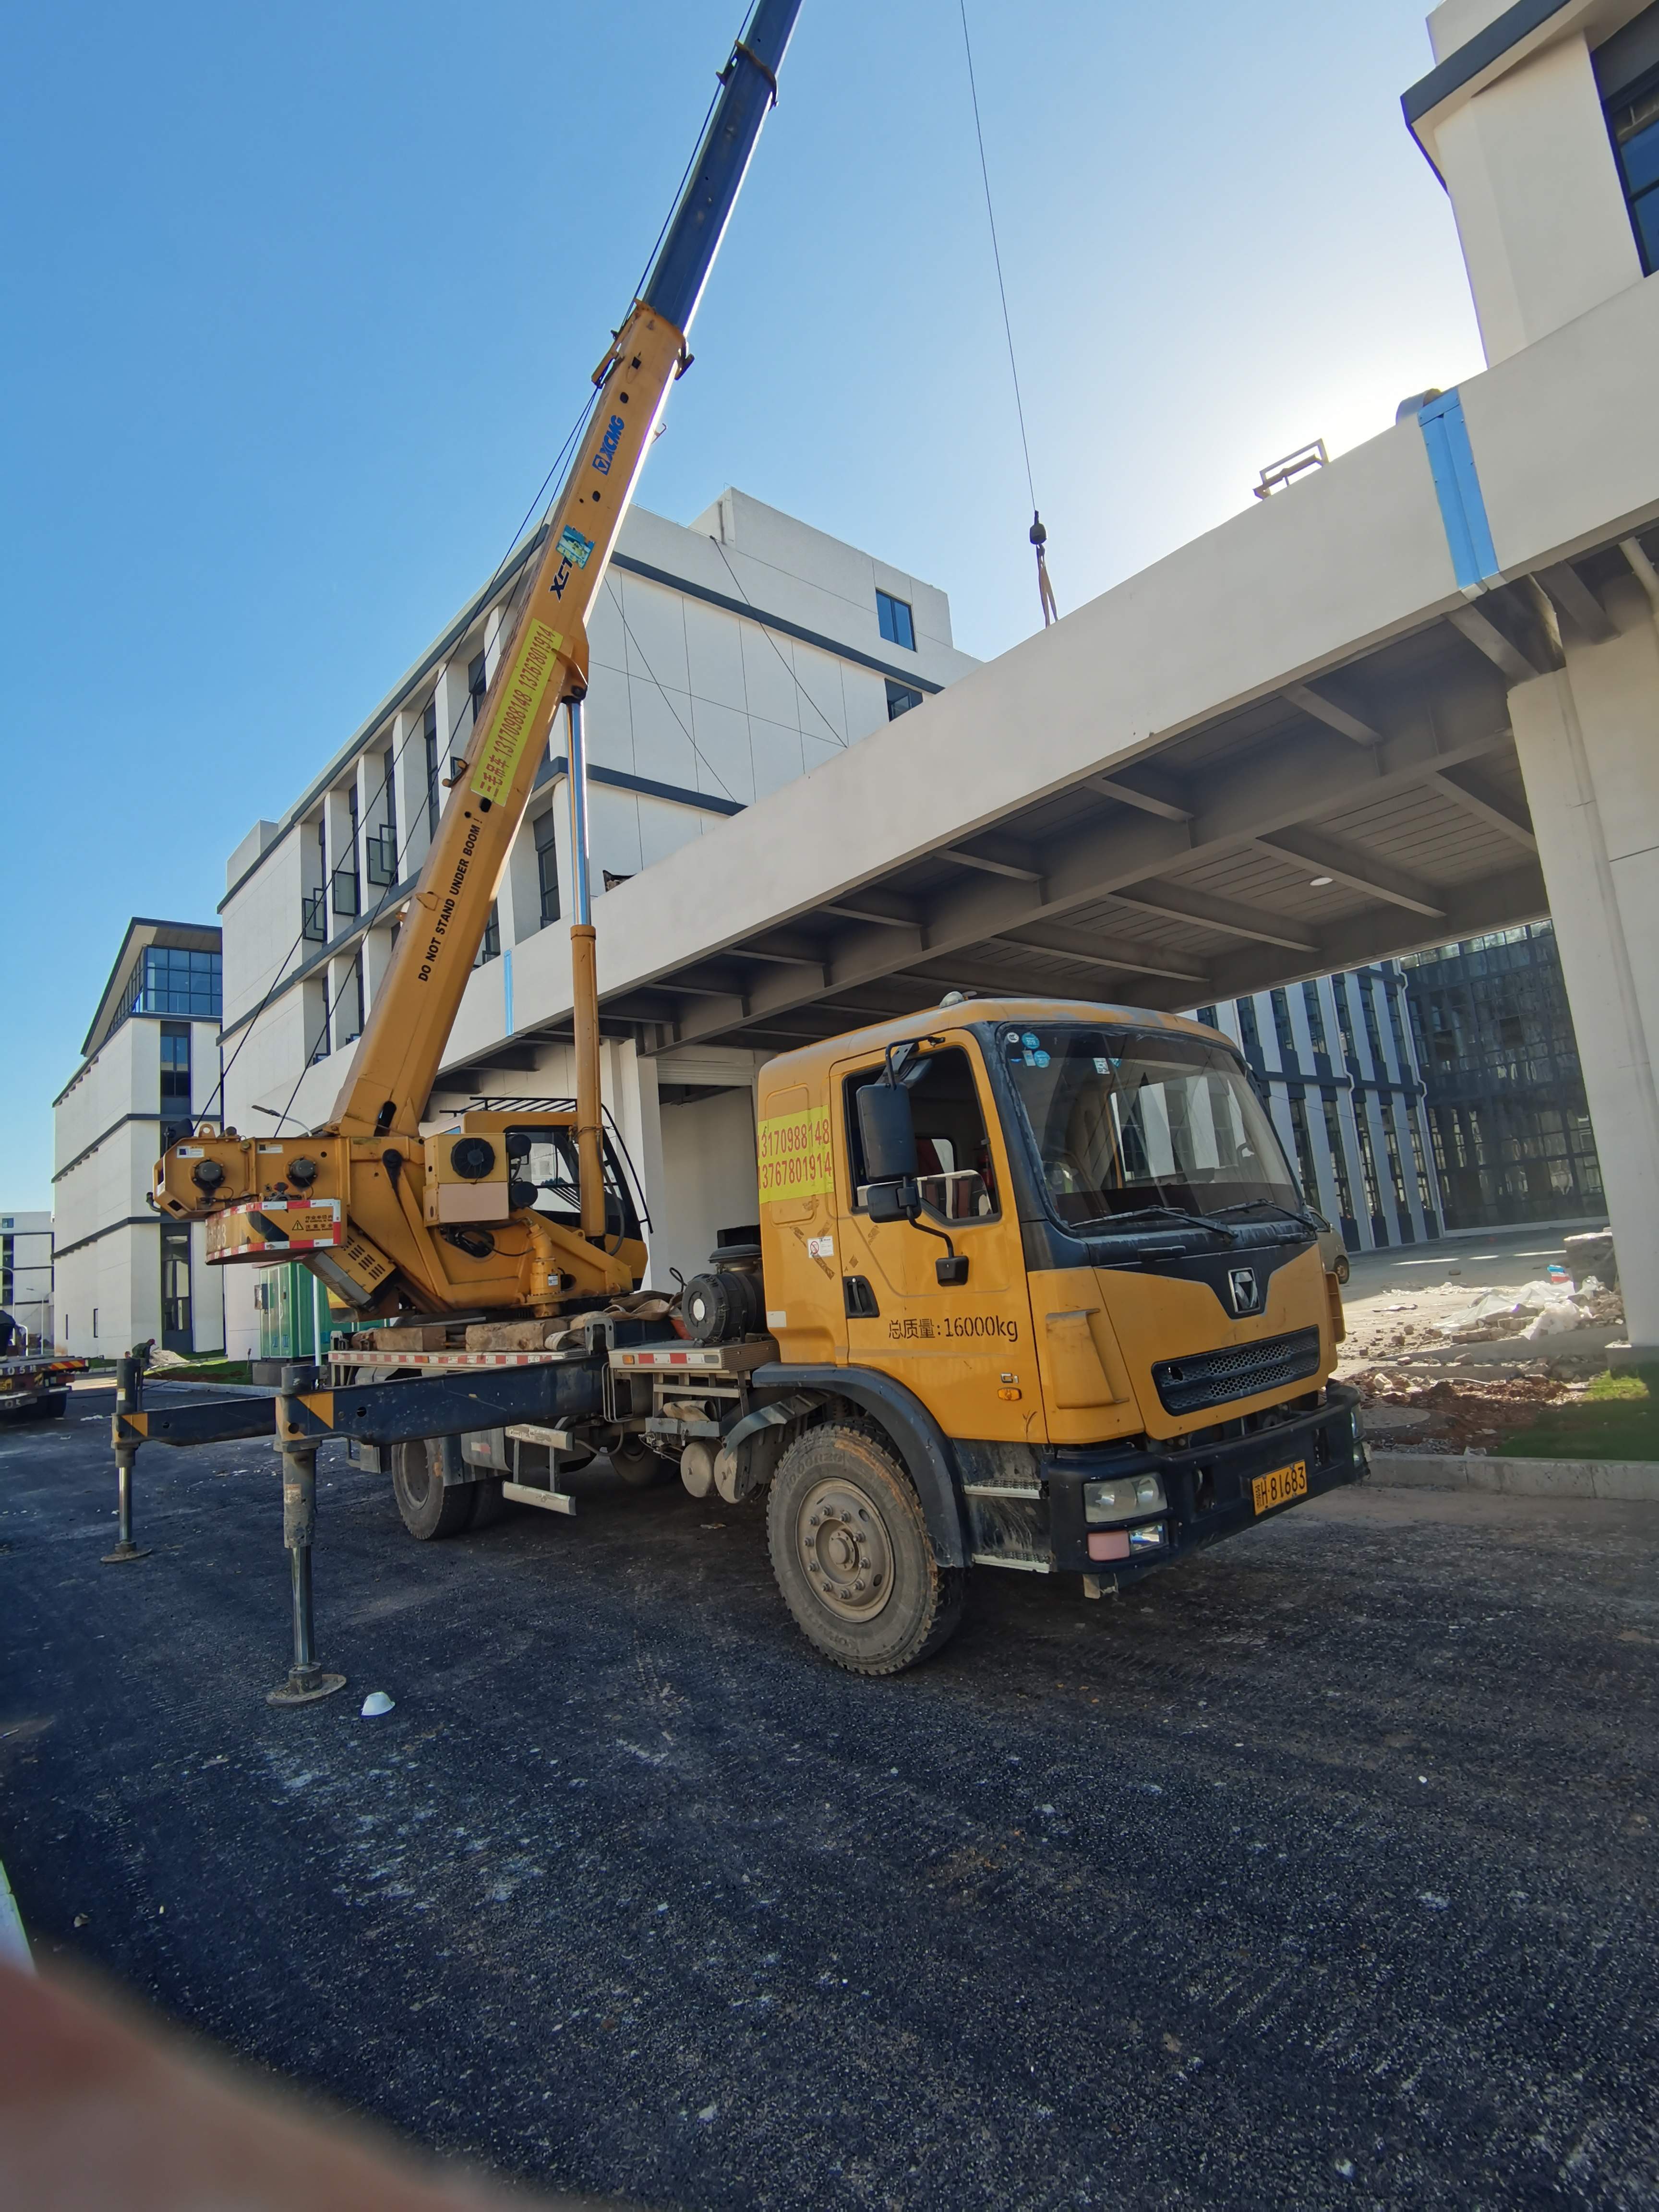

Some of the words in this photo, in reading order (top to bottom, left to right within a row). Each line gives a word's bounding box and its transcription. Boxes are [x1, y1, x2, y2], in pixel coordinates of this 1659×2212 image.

[600, 415, 625, 461] XCMG
[493, 689, 532, 757] 13170988148
[518, 625, 556, 691] 13767801914
[418, 967, 432, 982] DO
[425, 937, 442, 962] NOT
[435, 898, 455, 935] STAND
[449, 859, 469, 895] UNDER
[757, 1118, 830, 1158] 13170988148
[758, 1152, 832, 1190] 13767801914
